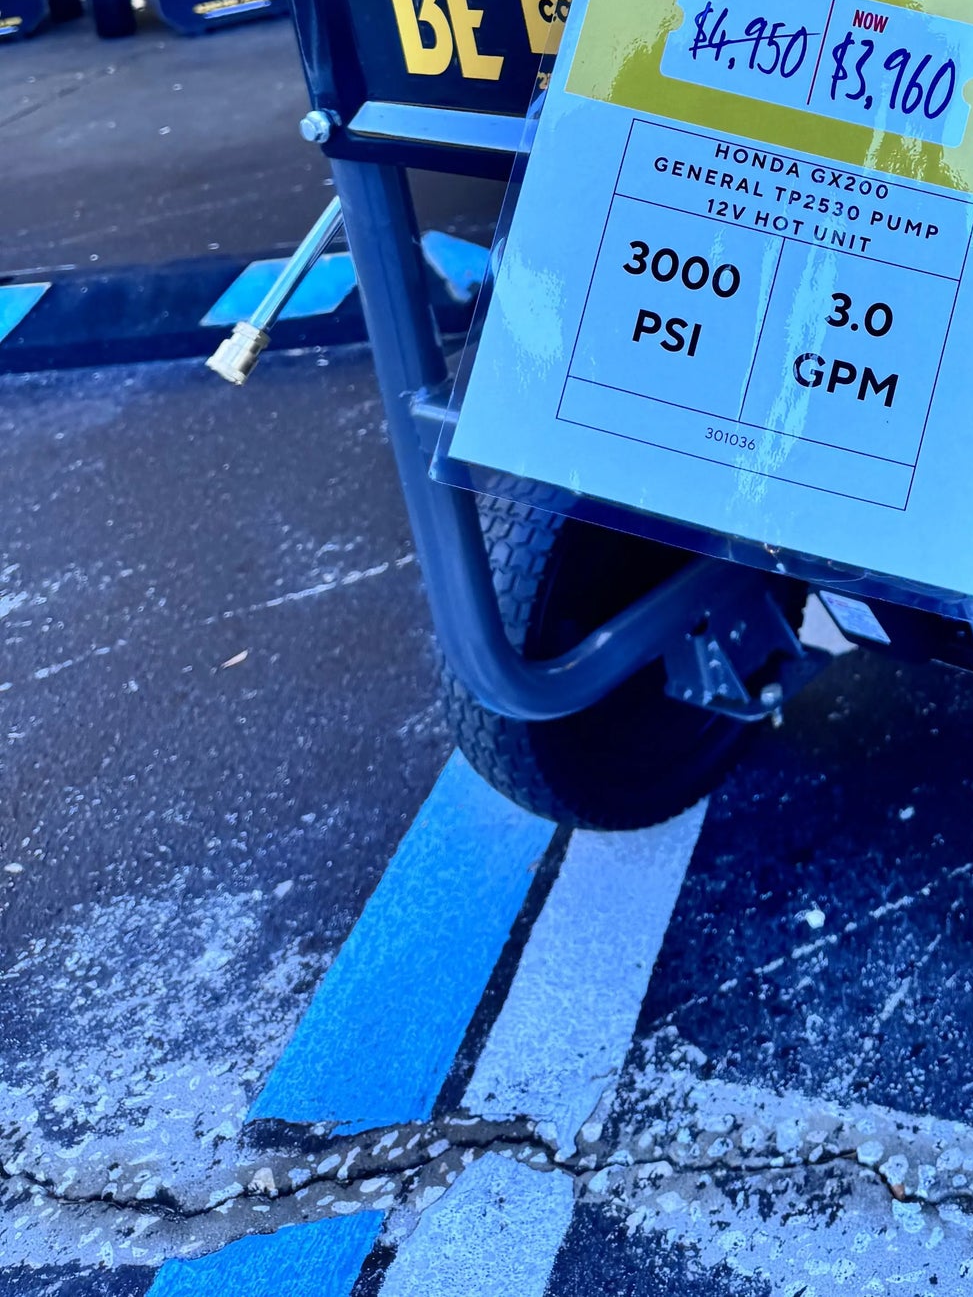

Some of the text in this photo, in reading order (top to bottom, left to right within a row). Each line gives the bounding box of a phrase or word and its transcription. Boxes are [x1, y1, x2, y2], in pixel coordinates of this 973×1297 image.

[852, 10, 888, 33] NOW
[830, 32, 956, 119] $3,960
[654, 156, 940, 240] GENERAL TP2530 PUMP
[715, 143, 889, 199] HONDA GX200
[707, 199, 871, 253] 12V HOT UNIT
[623, 240, 741, 298] 3000
[632, 309, 702, 357] PSI
[825, 292, 893, 337] 3.0
[793, 352, 899, 407] GPM
[705, 427, 756, 451] 301036
